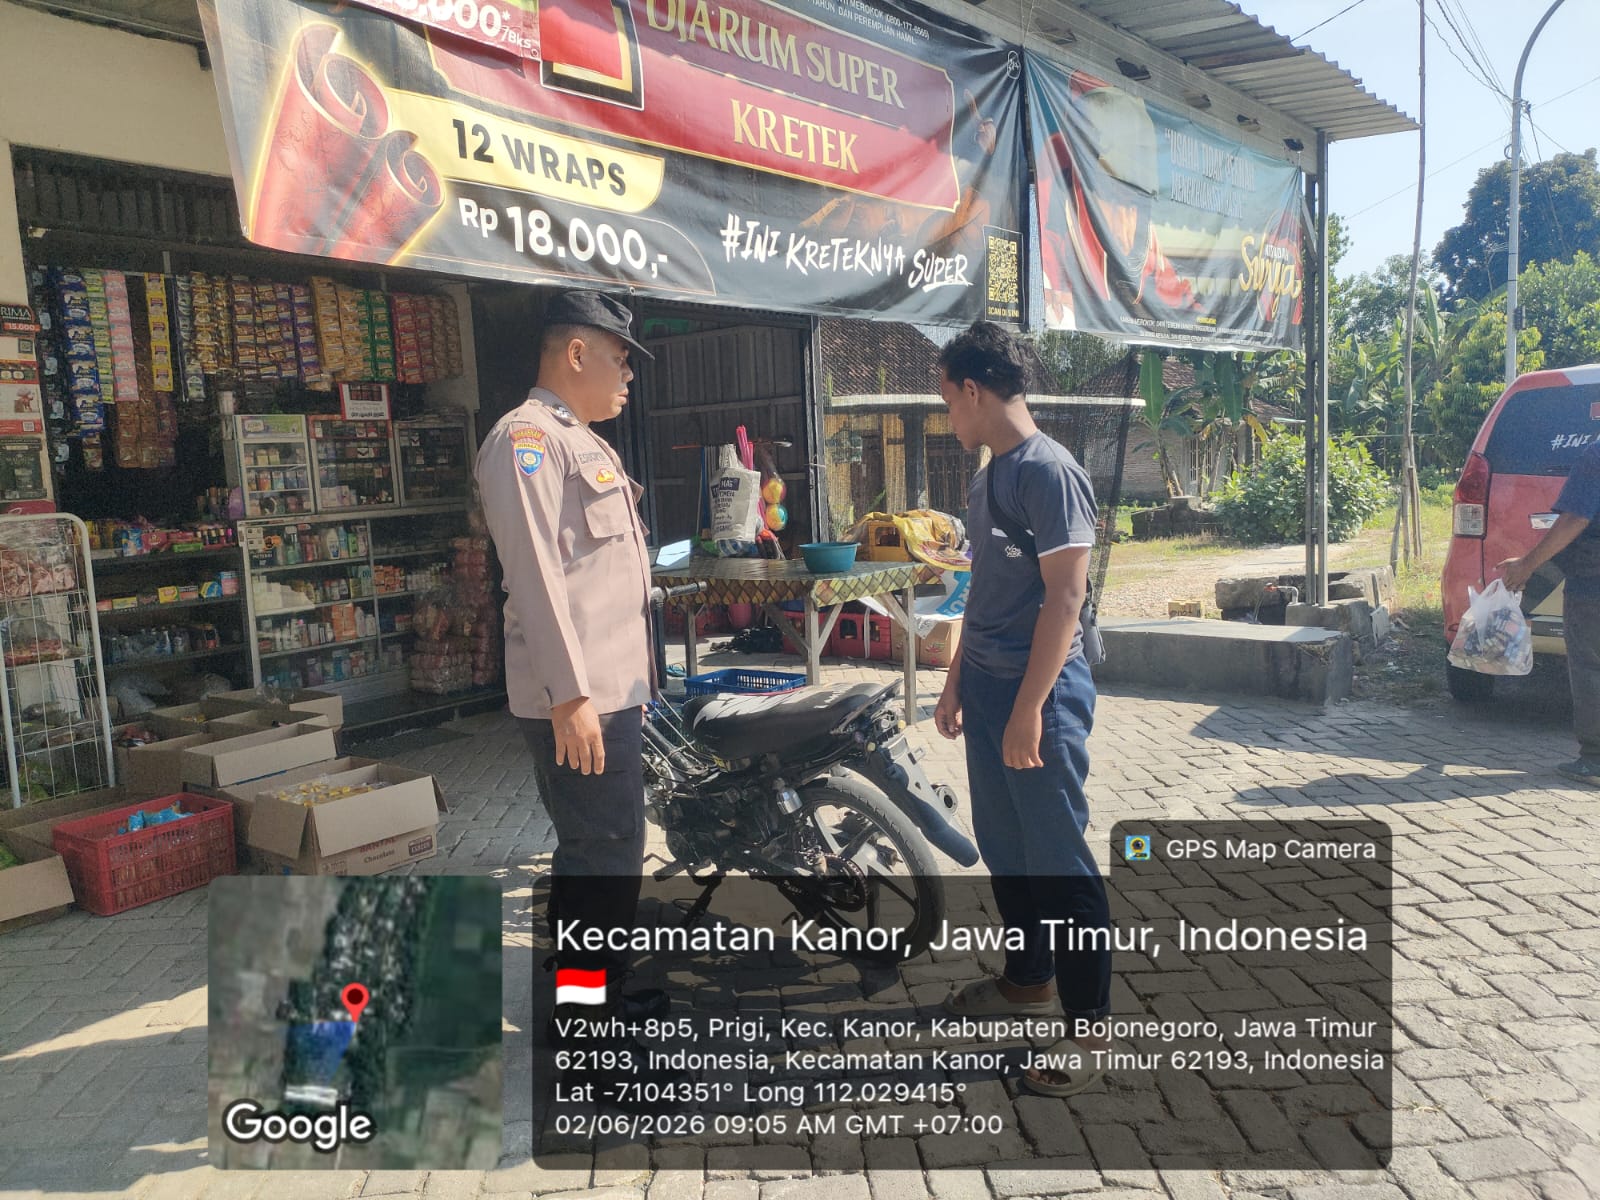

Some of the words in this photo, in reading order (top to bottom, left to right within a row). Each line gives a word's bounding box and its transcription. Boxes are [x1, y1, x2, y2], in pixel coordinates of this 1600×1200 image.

[646, 0, 801, 77] DJARUM
[806, 42, 905, 109] SUPER
[838, 6, 853, 20] DAN
[854, 12, 895, 37] PEREMPUAN
[452, 118, 494, 164] 12
[502, 134, 626, 196] WRAPS
[730, 98, 860, 175] KRETEK
[458, 197, 498, 239] Rp
[505, 206, 668, 279] 18.000,-
[720, 213, 781, 264] #INI
[785, 232, 906, 277] KRETEKNYA
[908, 248, 974, 293] SUPER
[1550, 433, 1592, 451] #INI
